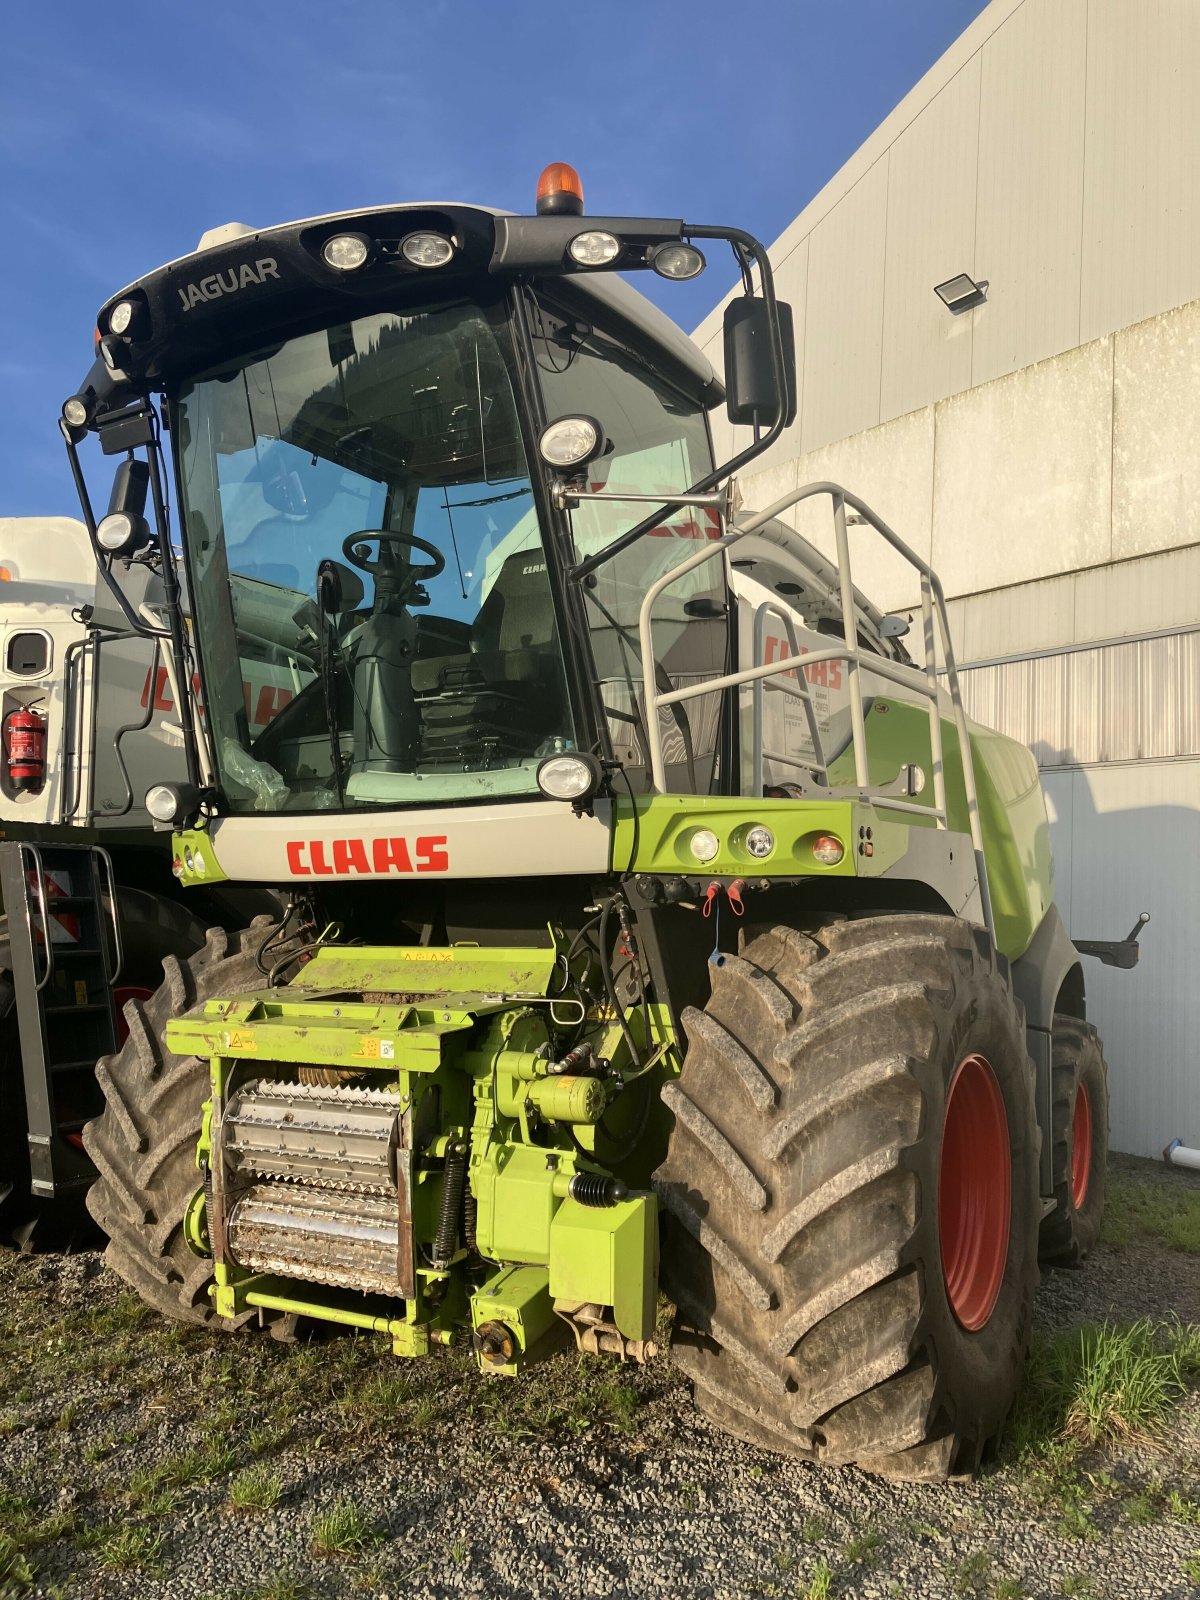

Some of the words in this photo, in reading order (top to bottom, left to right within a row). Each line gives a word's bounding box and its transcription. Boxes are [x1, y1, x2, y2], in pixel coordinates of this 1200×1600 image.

[177, 257, 280, 312] JAGUAR
[522, 563, 547, 575] CLAA
[286, 835, 449, 875] CLAAS
